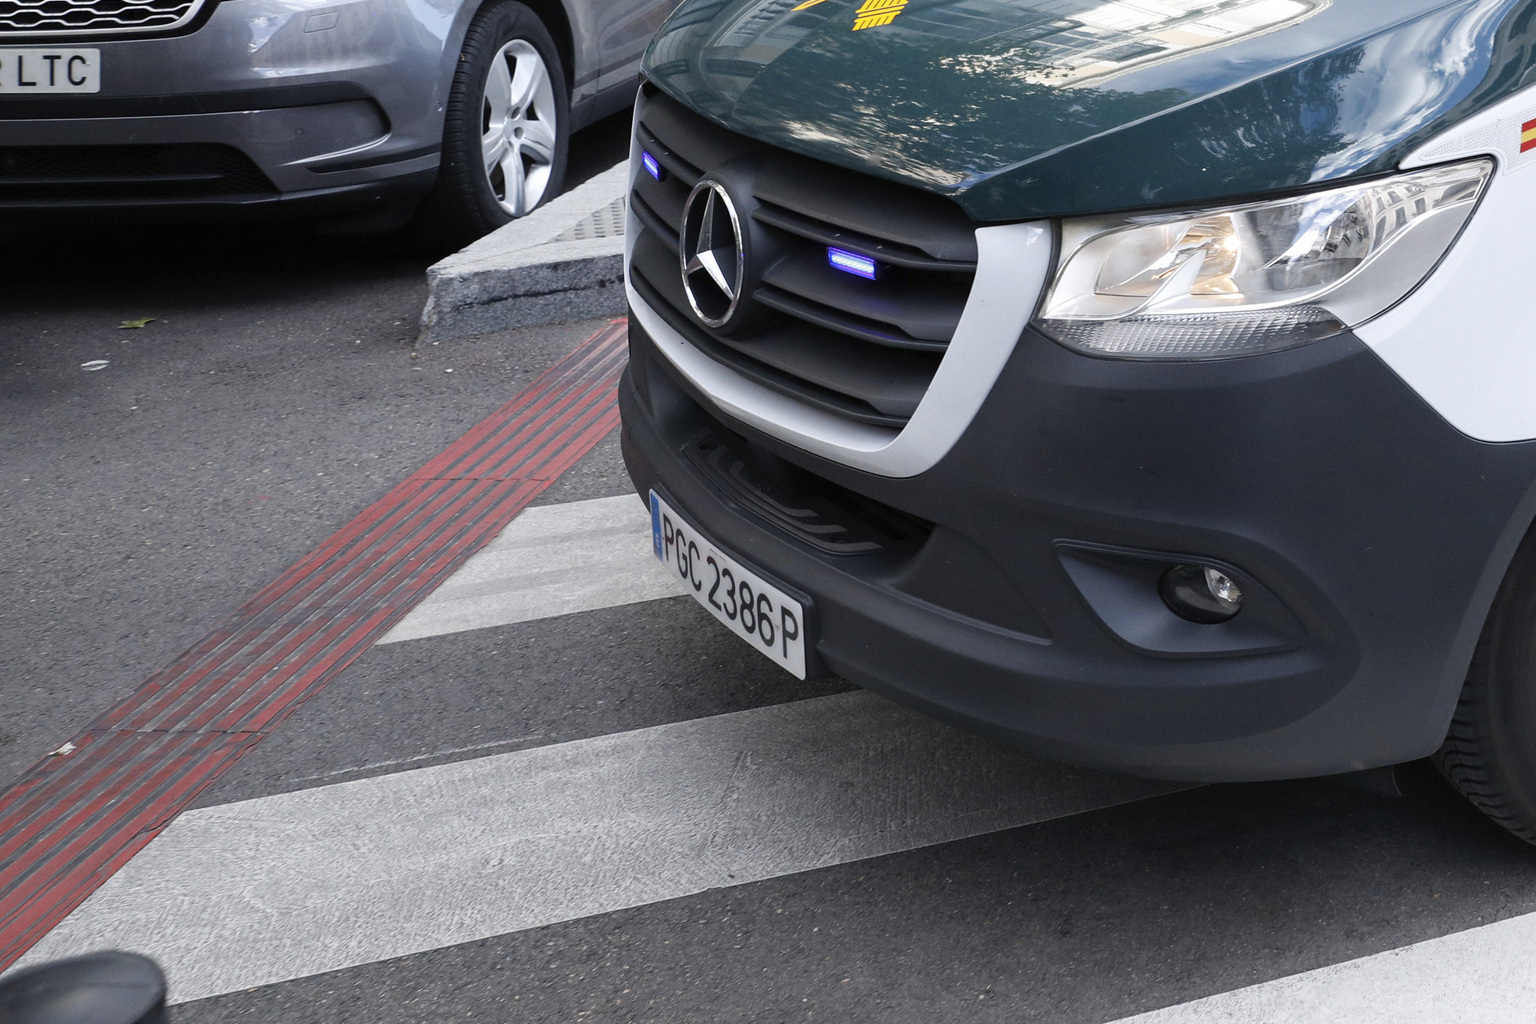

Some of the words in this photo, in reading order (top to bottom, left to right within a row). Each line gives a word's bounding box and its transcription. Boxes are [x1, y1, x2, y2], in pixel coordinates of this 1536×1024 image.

[17, 55, 87, 86] LTC
[662, 513, 702, 592] PGC
[706, 555, 775, 648] 2386
[781, 605, 799, 659] P
